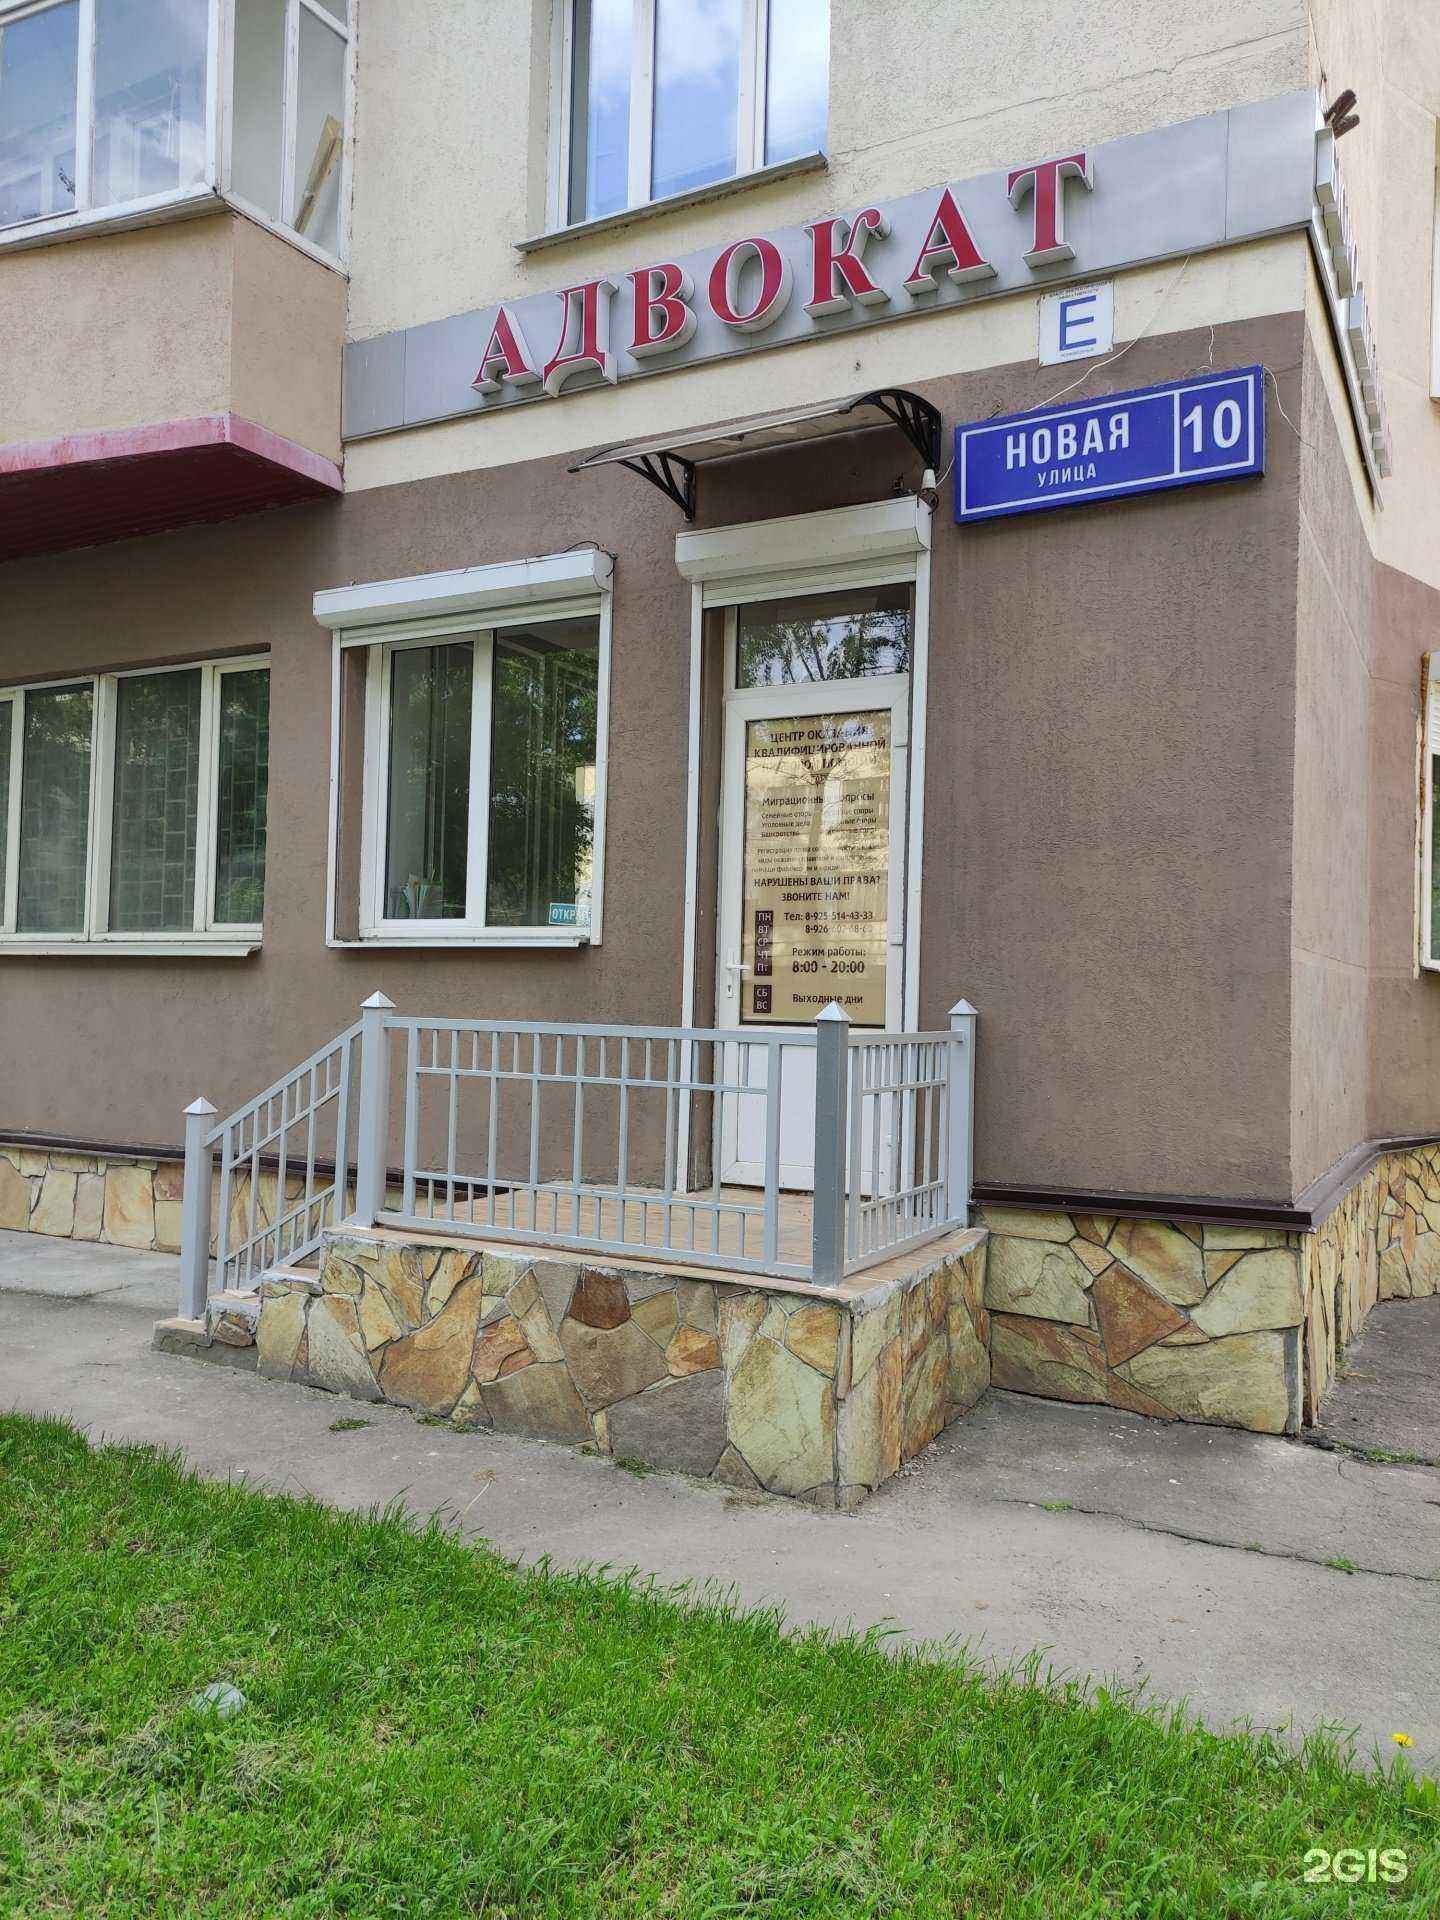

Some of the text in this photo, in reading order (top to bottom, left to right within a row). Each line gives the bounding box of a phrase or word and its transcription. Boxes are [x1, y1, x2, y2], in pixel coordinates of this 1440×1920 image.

[470, 151, 1094, 398] АДВОКАТ
[1183, 399, 1242, 453] 10
[1006, 412, 1130, 470] НОВАЯ
[1037, 463, 1097, 488] УЛИЦА
[770, 730, 805, 743] ЦЕНТР
[754, 874, 881, 887] НАРУШЕНЫ ВАШИ ПРАВА?
[781, 891, 850, 902] ЗВОНИТЕ НАМ!
[758, 912, 772, 921] ПН
[784, 911, 803, 921] Тел:
[758, 925, 769, 934] ВТ
[757, 937, 769, 947] СР
[757, 950, 770, 960] ЧТ
[792, 946, 866, 958] Режим работы:
[792, 961, 818, 973] 8:00
[830, 960, 866, 974] 20:00
[756, 988, 768, 997] СБ
[792, 993, 864, 1005] Выходные дни
[756, 1001, 768, 1010] ВС
